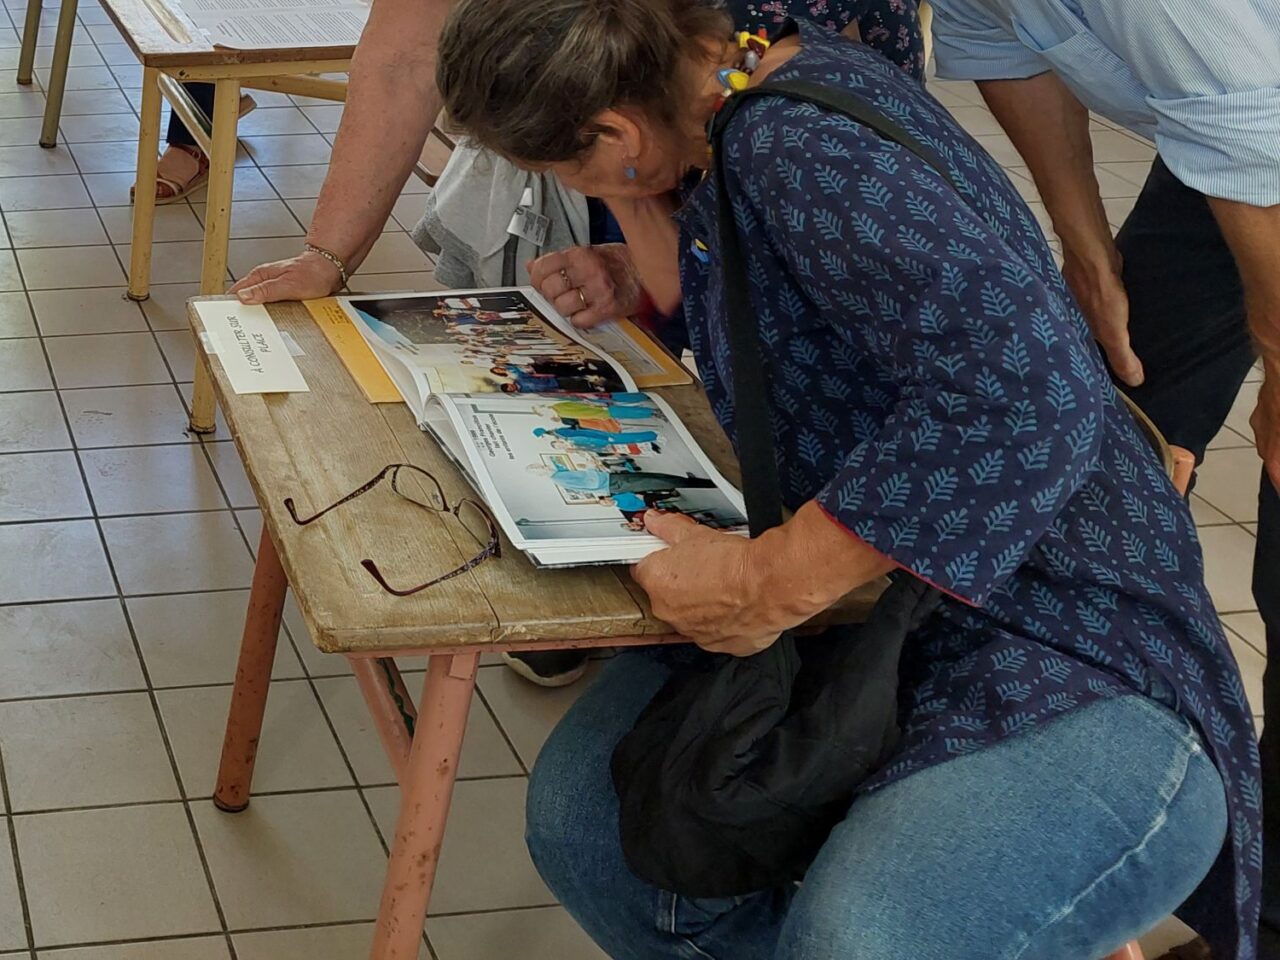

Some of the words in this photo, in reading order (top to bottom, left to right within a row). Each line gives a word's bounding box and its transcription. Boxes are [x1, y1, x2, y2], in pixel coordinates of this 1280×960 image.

[226, 316, 242, 329] SUR
[233, 329, 261, 367] CONSULTER
[251, 333, 272, 353] PLACE
